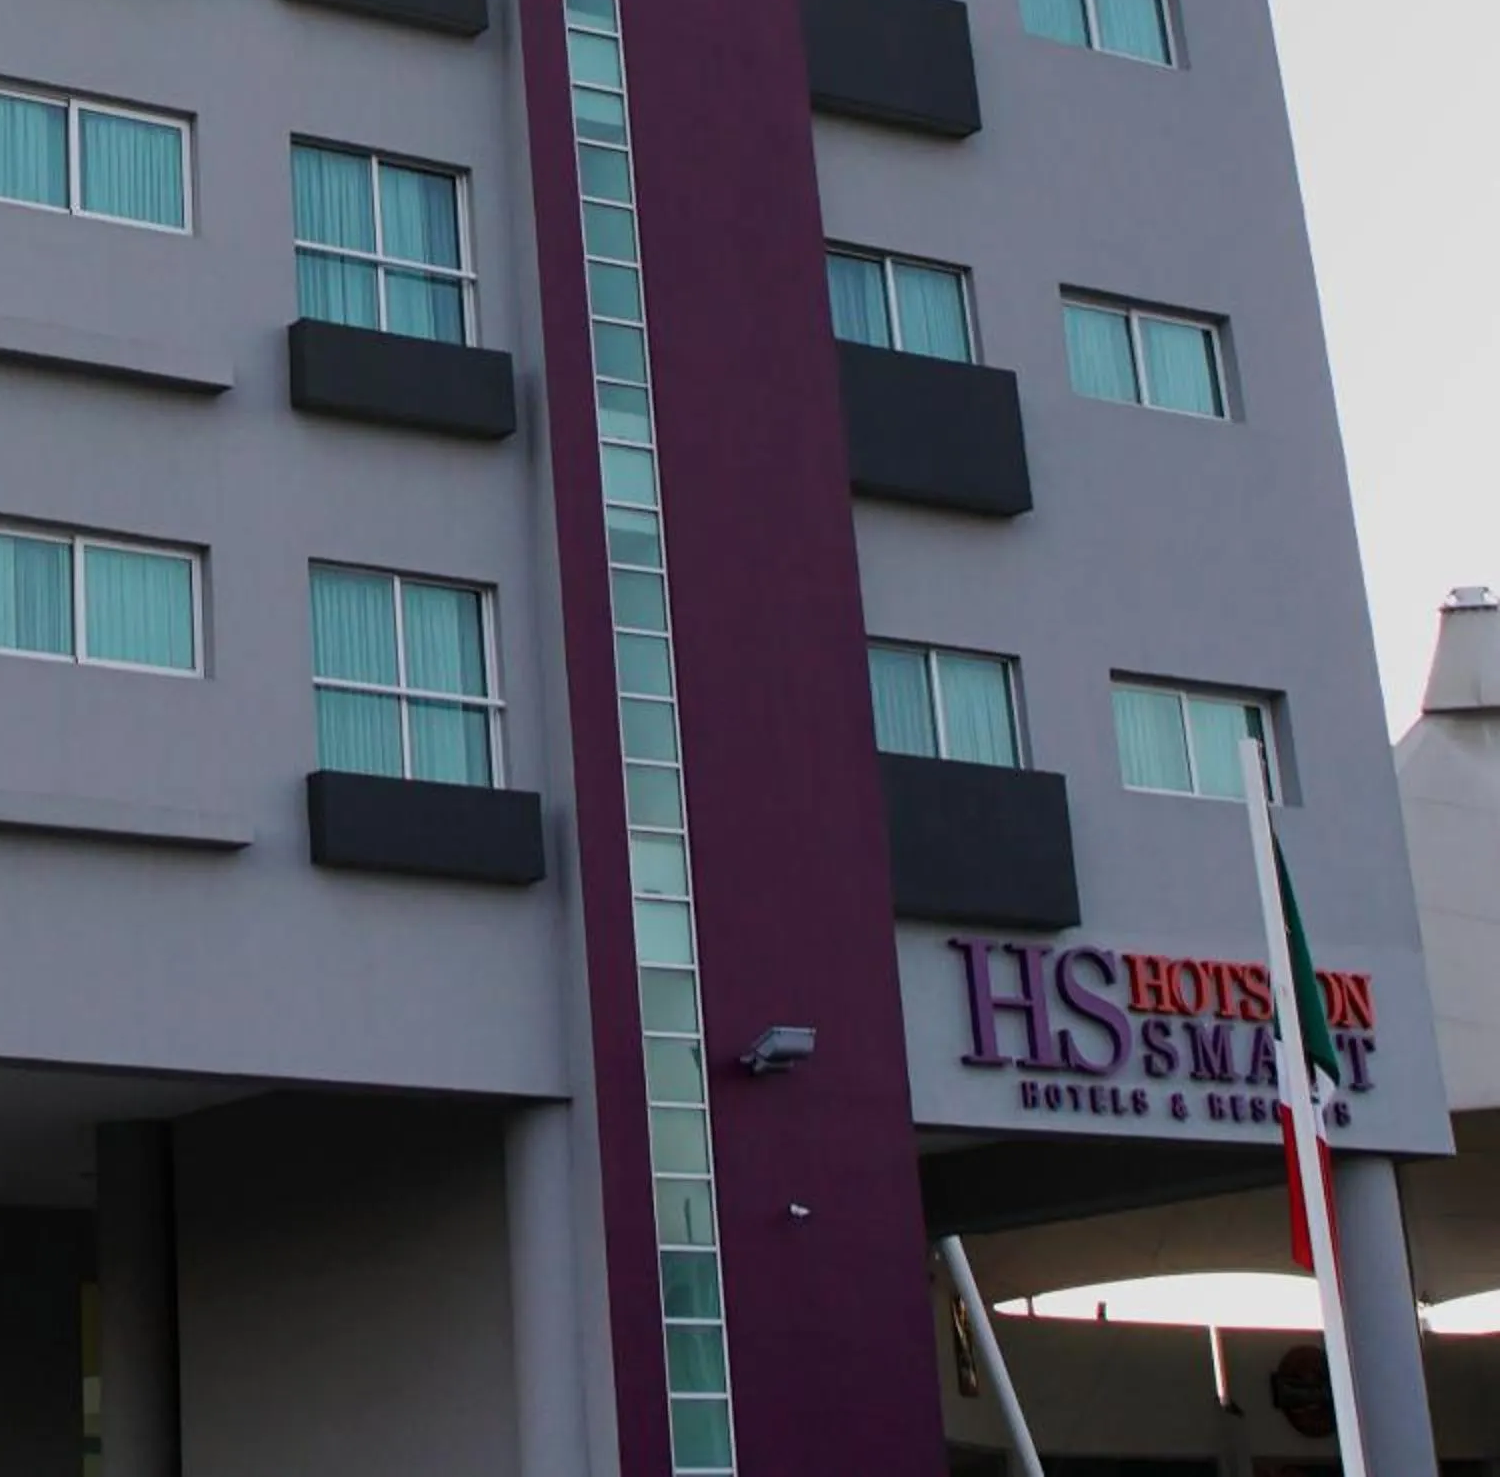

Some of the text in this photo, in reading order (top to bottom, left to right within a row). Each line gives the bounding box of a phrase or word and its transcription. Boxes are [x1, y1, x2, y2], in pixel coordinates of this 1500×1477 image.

[947, 937, 1132, 1078] HS
[1122, 953, 1377, 1031] HOTSON
[1141, 1017, 1377, 1093] SMAT
[1021, 1080, 1149, 1117] HOTELS
[1169, 1090, 1189, 1123] &
